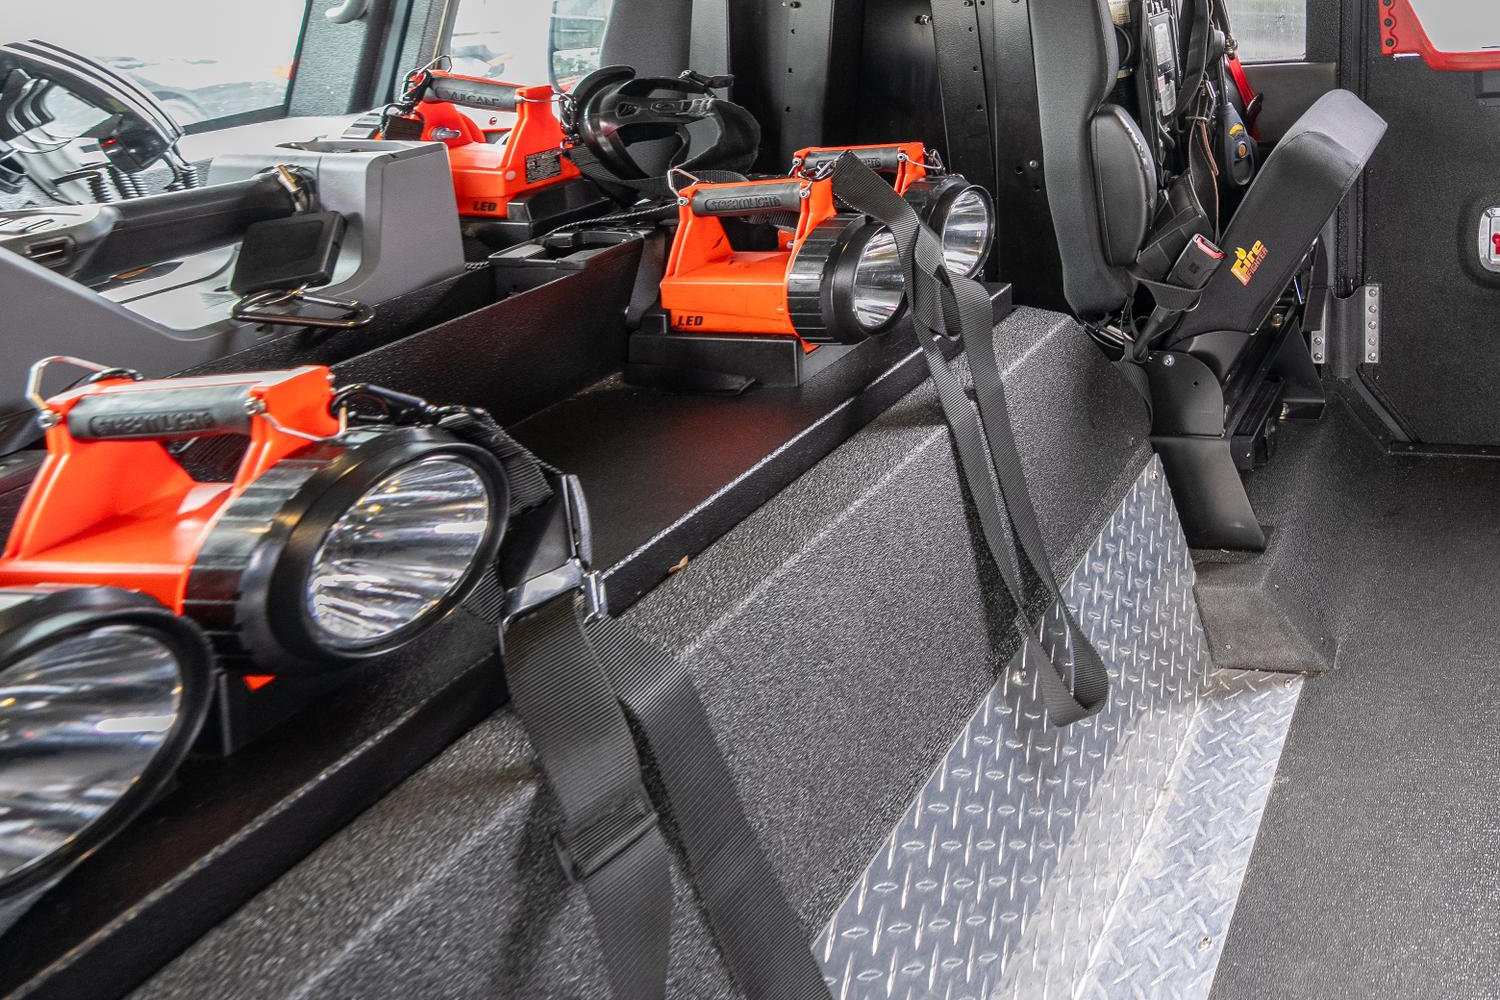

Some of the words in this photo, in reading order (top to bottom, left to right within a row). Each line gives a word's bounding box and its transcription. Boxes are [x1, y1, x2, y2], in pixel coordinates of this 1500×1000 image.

[473, 201, 497, 212] LED
[1231, 240, 1264, 286] Fire
[677, 315, 704, 327] LED
